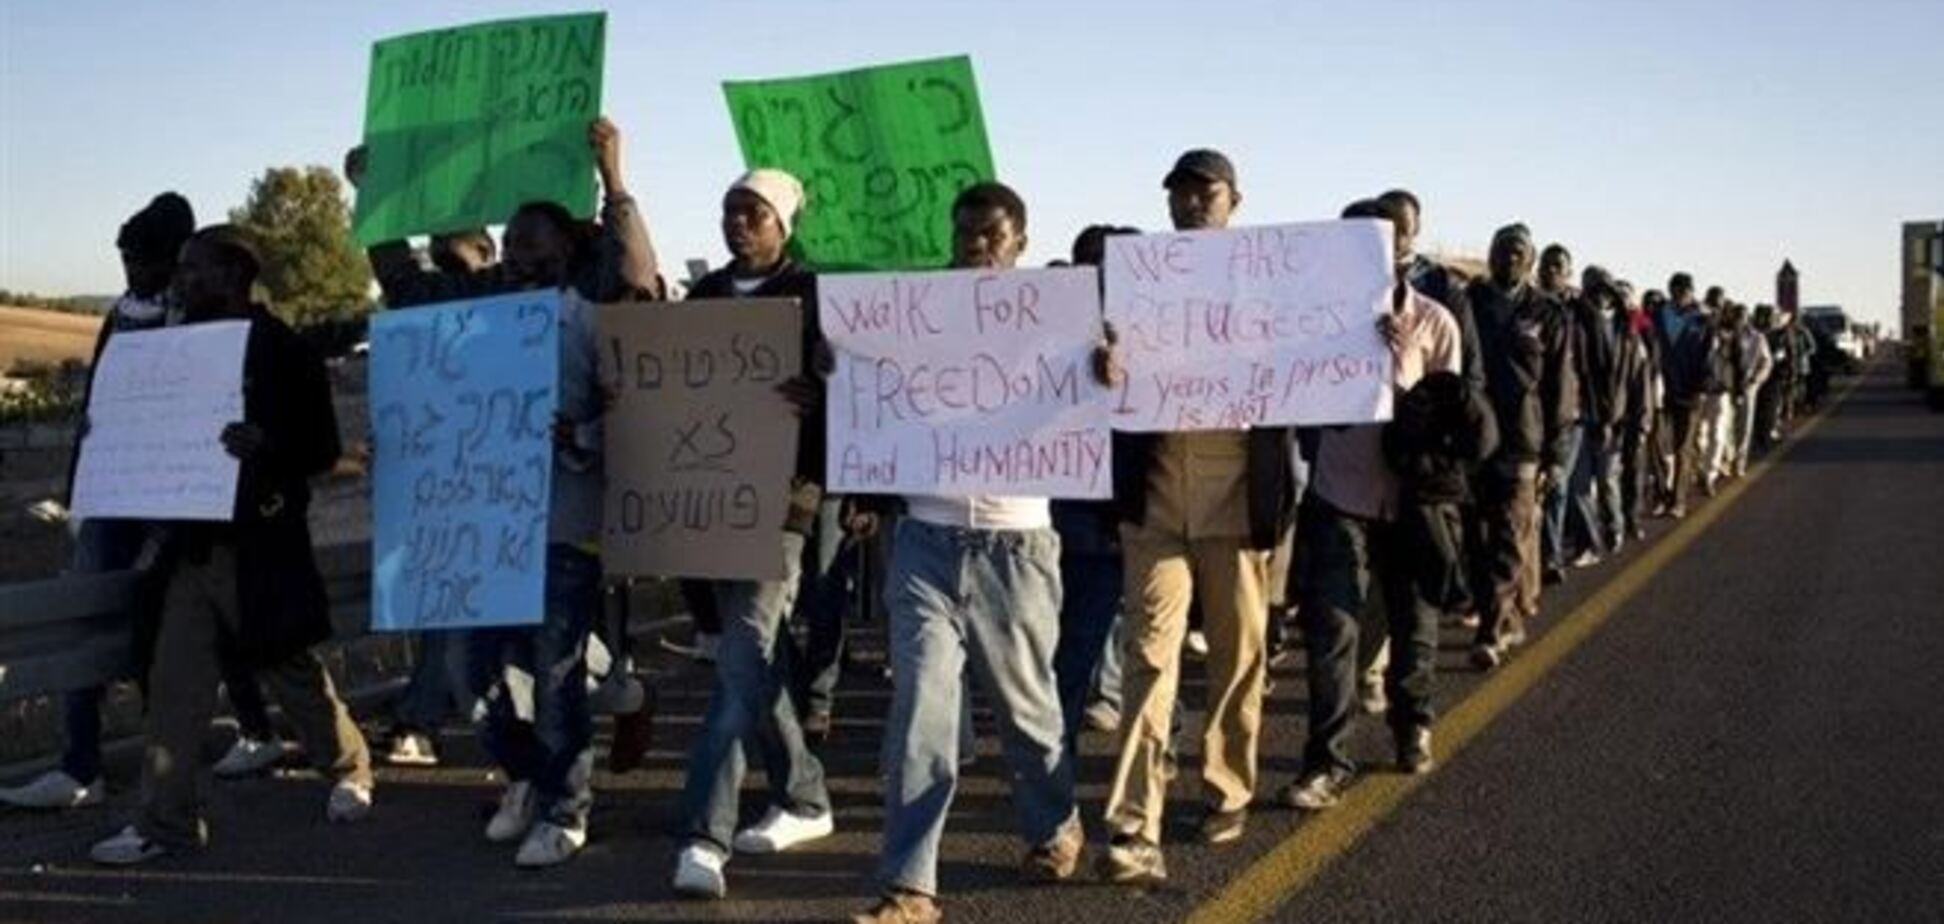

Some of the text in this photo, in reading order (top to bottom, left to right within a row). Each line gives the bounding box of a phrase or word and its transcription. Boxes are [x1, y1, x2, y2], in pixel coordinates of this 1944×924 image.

[906, 76, 971, 135] כי
[668, 411, 737, 462] לא
[606, 483, 761, 537] פושעים.
